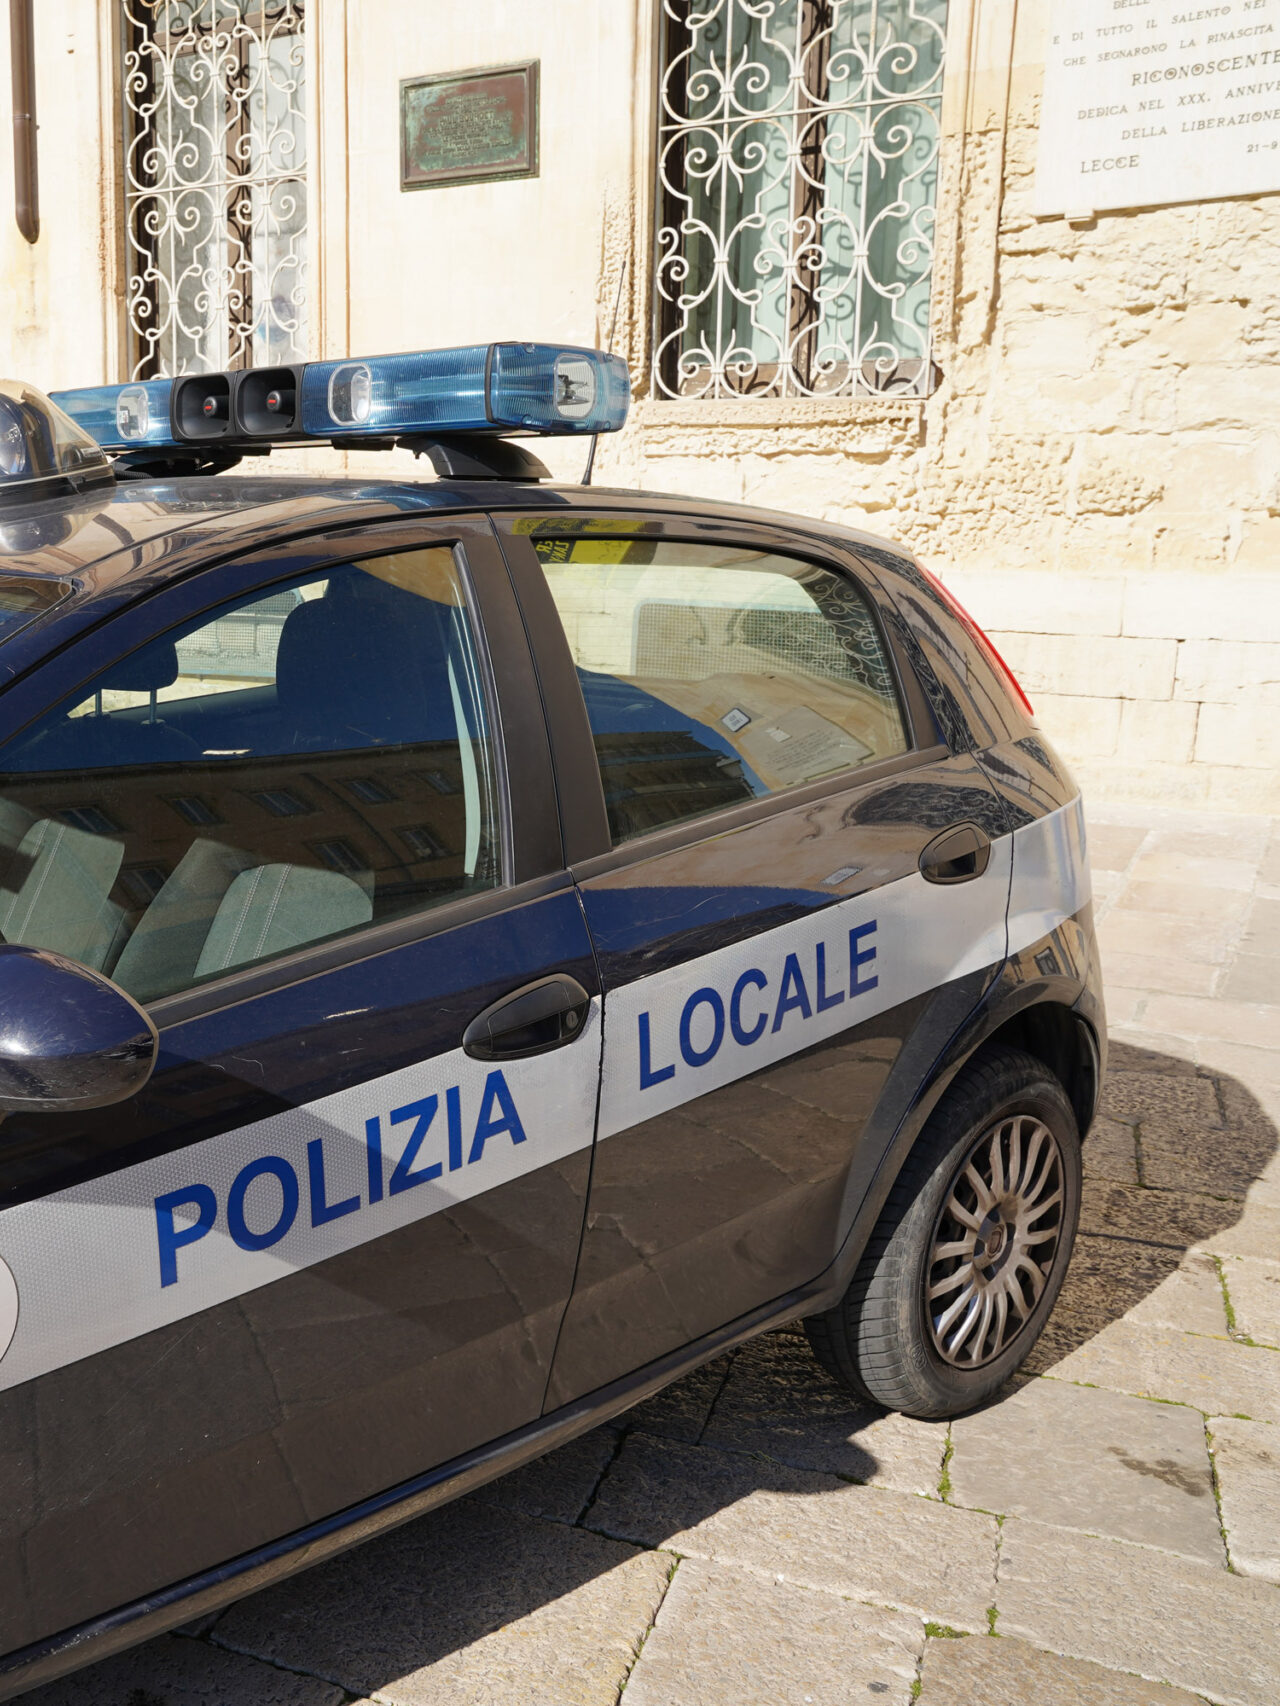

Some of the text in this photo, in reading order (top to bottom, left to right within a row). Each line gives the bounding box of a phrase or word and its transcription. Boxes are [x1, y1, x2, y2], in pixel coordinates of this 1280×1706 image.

[1053, 35, 1060, 45] E
[1072, 32, 1083, 41] DI
[1096, 24, 1133, 37] TUTTO
[1146, 20, 1157, 29] IL
[1171, 6, 1232, 25] SALENTO
[1063, 24, 1274, 67] CHE SEGNARONO LA RINASCITA
[1131, 49, 1280, 87] RICONOSCENTE
[1077, 104, 1128, 120] DEDICA
[1138, 100, 1165, 112] NEL
[1121, 109, 1280, 141] DELLA LIBERAZIONE
[1080, 154, 1140, 174] LECCE
[638, 919, 879, 1092] LOCALE
[153, 1068, 527, 1289] POLIZIA
